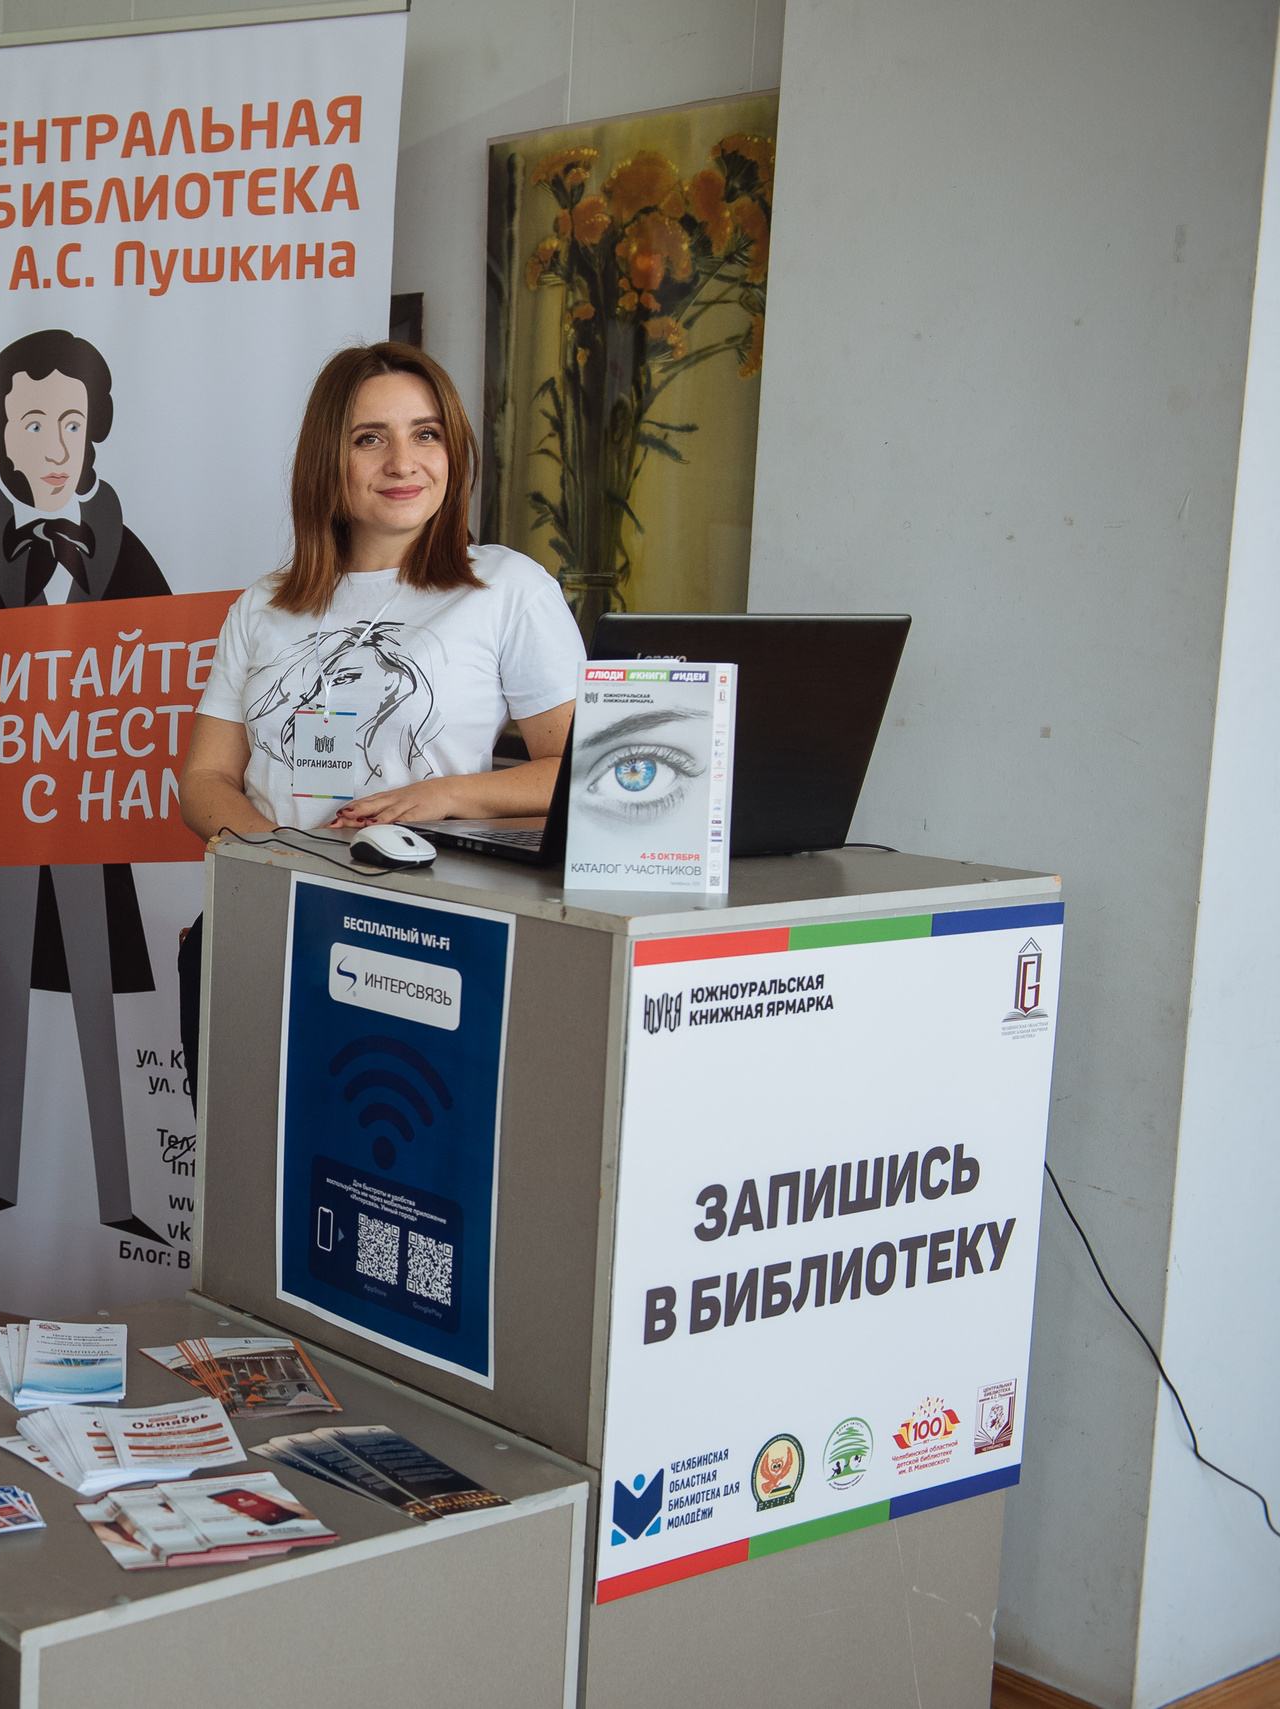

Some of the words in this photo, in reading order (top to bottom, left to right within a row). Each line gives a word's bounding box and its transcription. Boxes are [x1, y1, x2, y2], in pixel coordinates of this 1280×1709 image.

[10, 243, 94, 290] А.С.
[114, 240, 356, 296] Пушкина
[588, 670, 624, 680] #ЛЮДИ
[629, 672, 667, 680] #КНИГИ
[672, 672, 706, 682] #ИДЕИ
[296, 758, 352, 769] ОРГАНИЗАТОР
[22, 774, 58, 824] С
[571, 863, 622, 874] КАТАЛОГ
[624, 864, 702, 876] УЧАСТНИКОВ
[657, 853, 700, 861] ОКТЯБРЯ
[344, 916, 419, 944] БЕСПЛАТНЫЙ
[420, 933, 450, 950] Wi-Fi
[364, 972, 452, 1006] ИНТЕРСВЯЗЬ
[690, 974, 824, 1004] ЮЖНОУРАЛЬСКАЯ
[689, 1003, 764, 1026] КНИЖНАЯ
[766, 995, 834, 1017] ЯРМАРКА
[136, 1049, 163, 1068] ул.
[170, 1050, 185, 1069] К
[148, 1076, 175, 1094] ул.
[694, 1143, 980, 1242] ЗАПИШИСЬ
[120, 1240, 170, 1266] Блог:
[644, 1286, 677, 1345] В
[689, 1218, 1016, 1335] БИБЛИОТЕКУ
[132, 1413, 208, 1429] Октябрь
[912, 1416, 942, 1441] 100
[670, 1448, 729, 1474] ЧЕЛЯБИНСКАЯ
[670, 1469, 717, 1494] ОБЛАСТНАЯ
[668, 1487, 721, 1512] БИБЛИОТЕКА
[722, 1481, 740, 1497] ДЛЯ
[666, 1506, 714, 1530] МОЛОДЁЖИ
